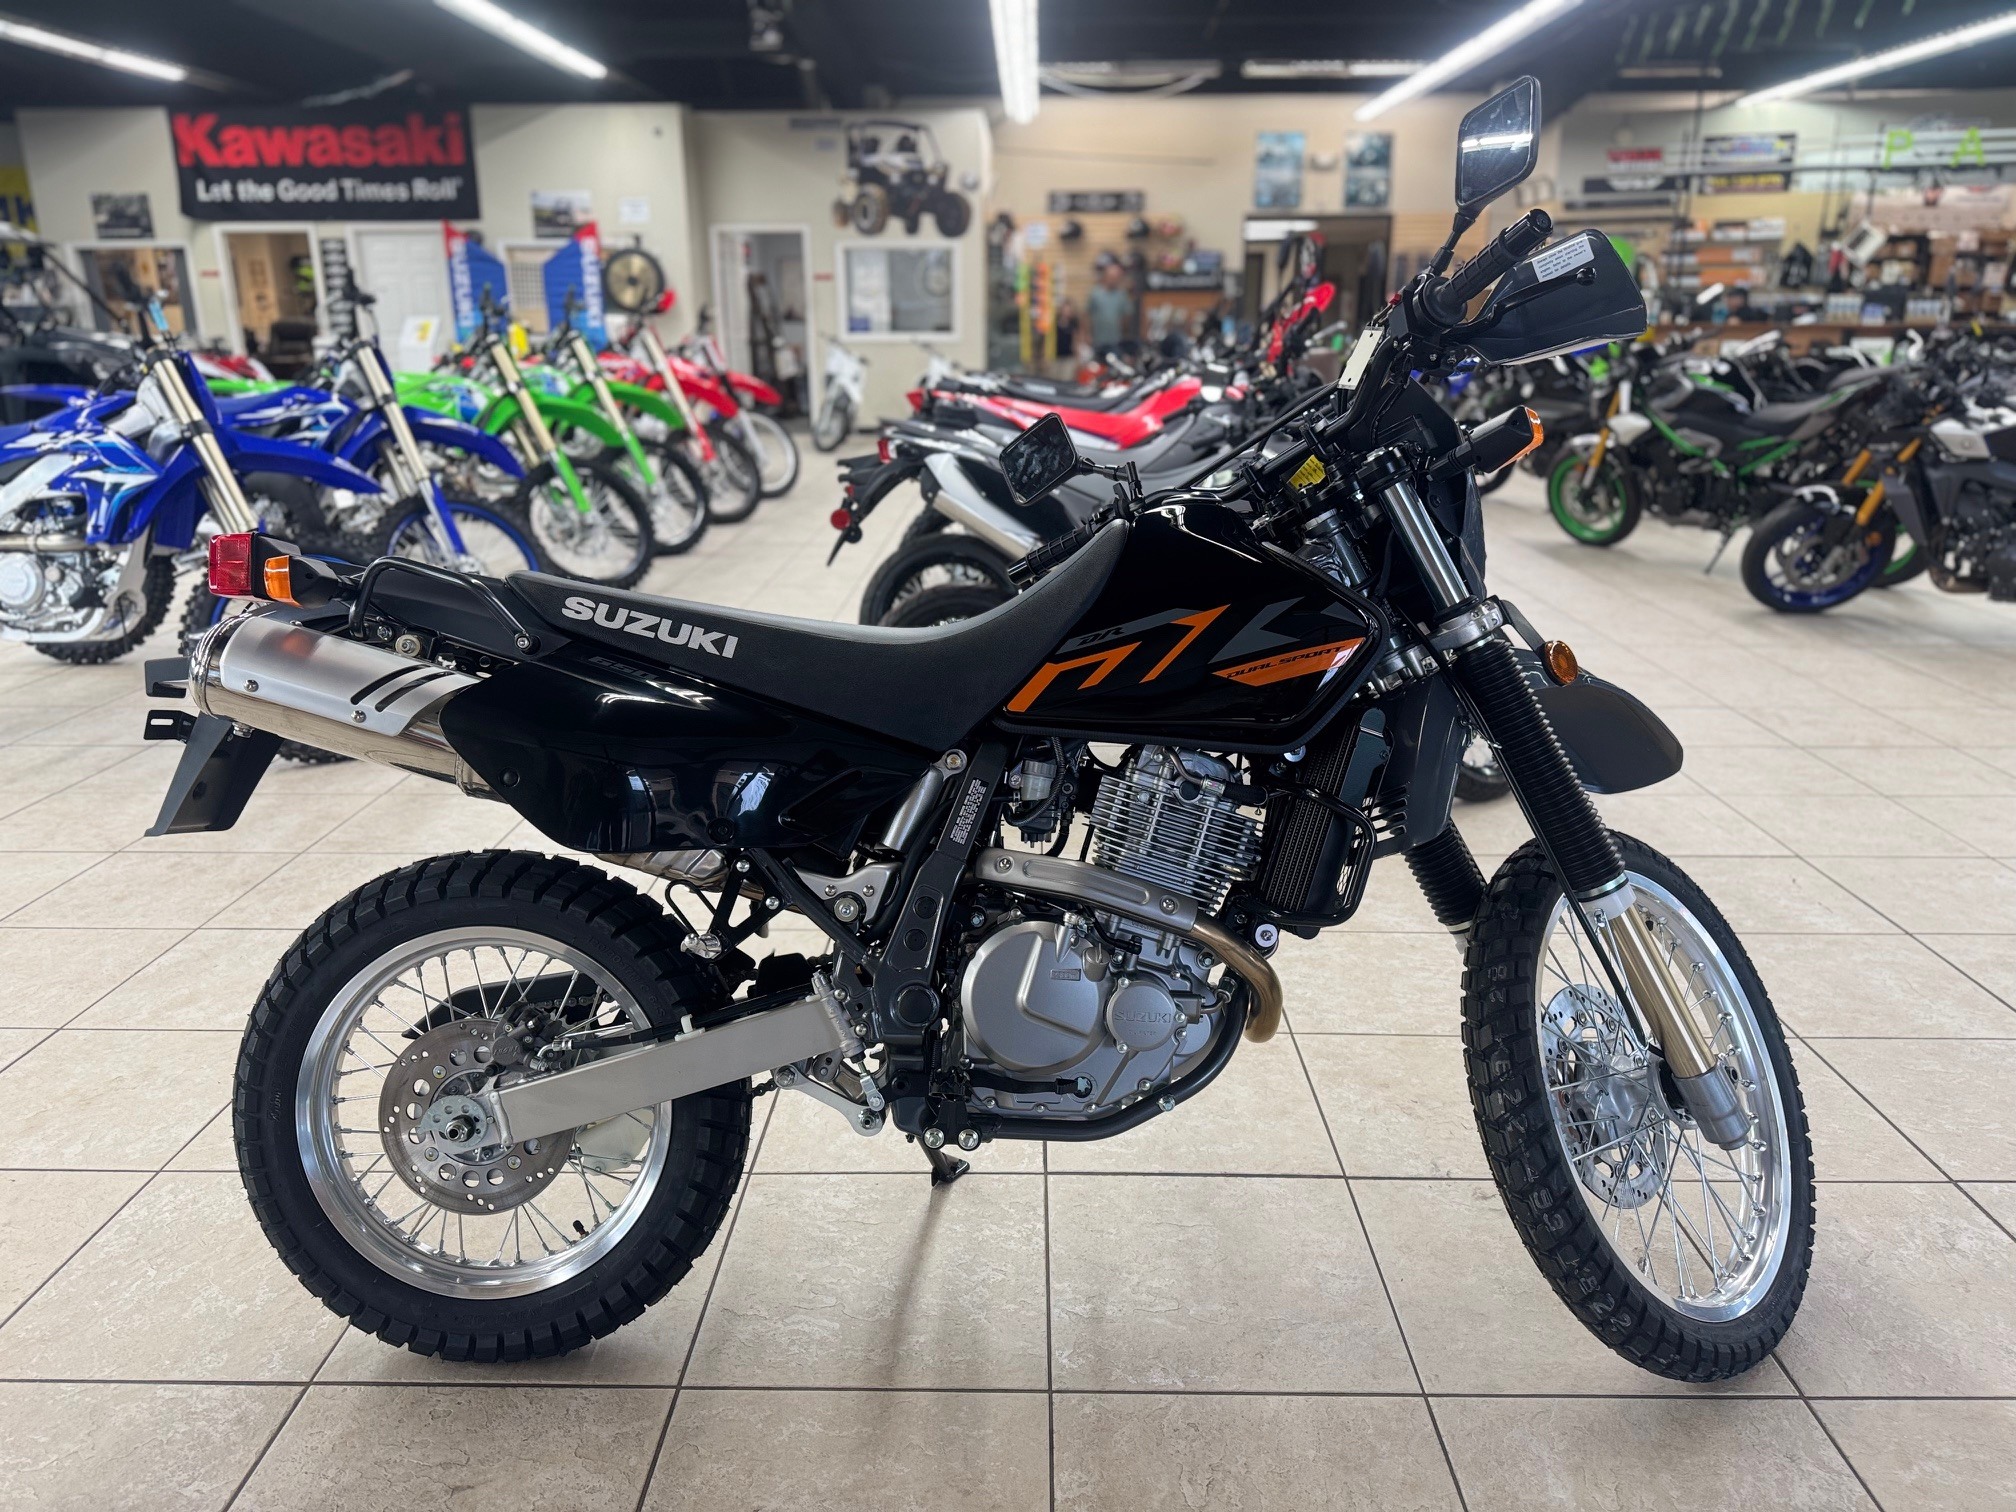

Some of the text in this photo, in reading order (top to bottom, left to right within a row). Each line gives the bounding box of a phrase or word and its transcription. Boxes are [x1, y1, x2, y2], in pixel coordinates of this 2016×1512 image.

[171, 113, 467, 168] Kawasaki
[196, 178, 233, 203] Let
[236, 177, 276, 203] the
[276, 177, 339, 203] Good
[340, 177, 410, 203] Times
[561, 596, 739, 659] SUZUKI
[1226, 645, 1346, 679] DUAL SPORT
[1114, 1011, 1171, 1023] SUZUKI
